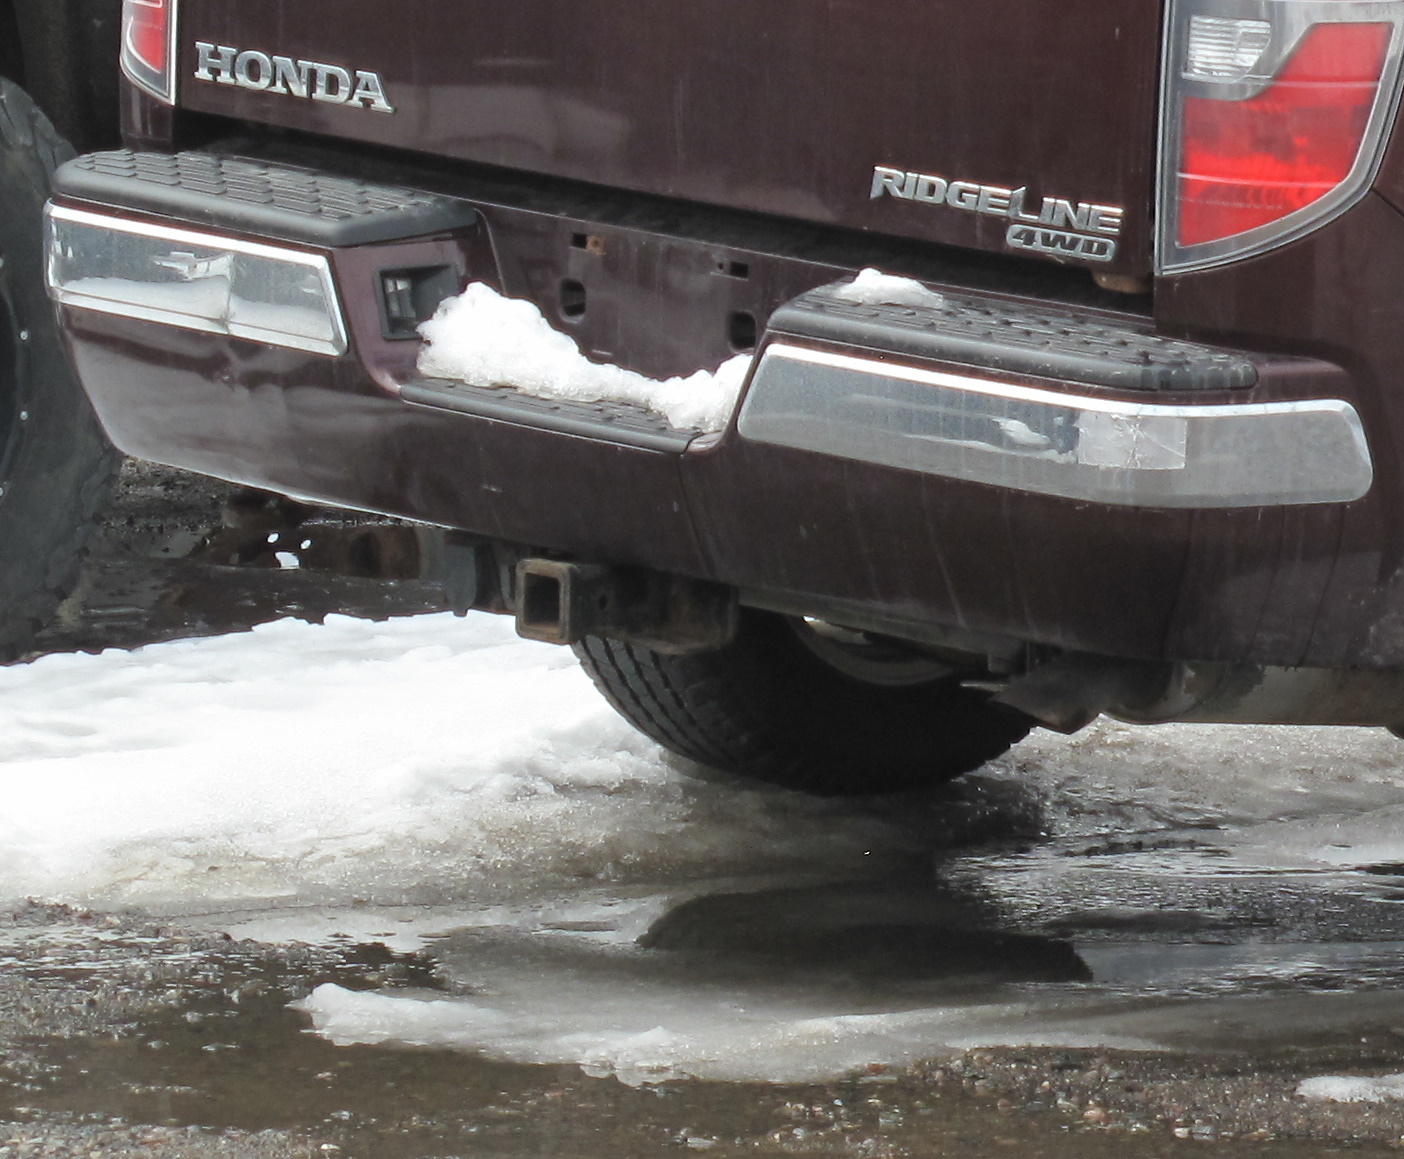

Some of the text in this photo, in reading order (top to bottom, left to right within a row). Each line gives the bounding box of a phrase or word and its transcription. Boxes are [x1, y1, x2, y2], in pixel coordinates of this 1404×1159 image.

[194, 41, 396, 114] HONDA
[870, 165, 1125, 235] RIDGELINE
[1011, 227, 1110, 259] 4WD
